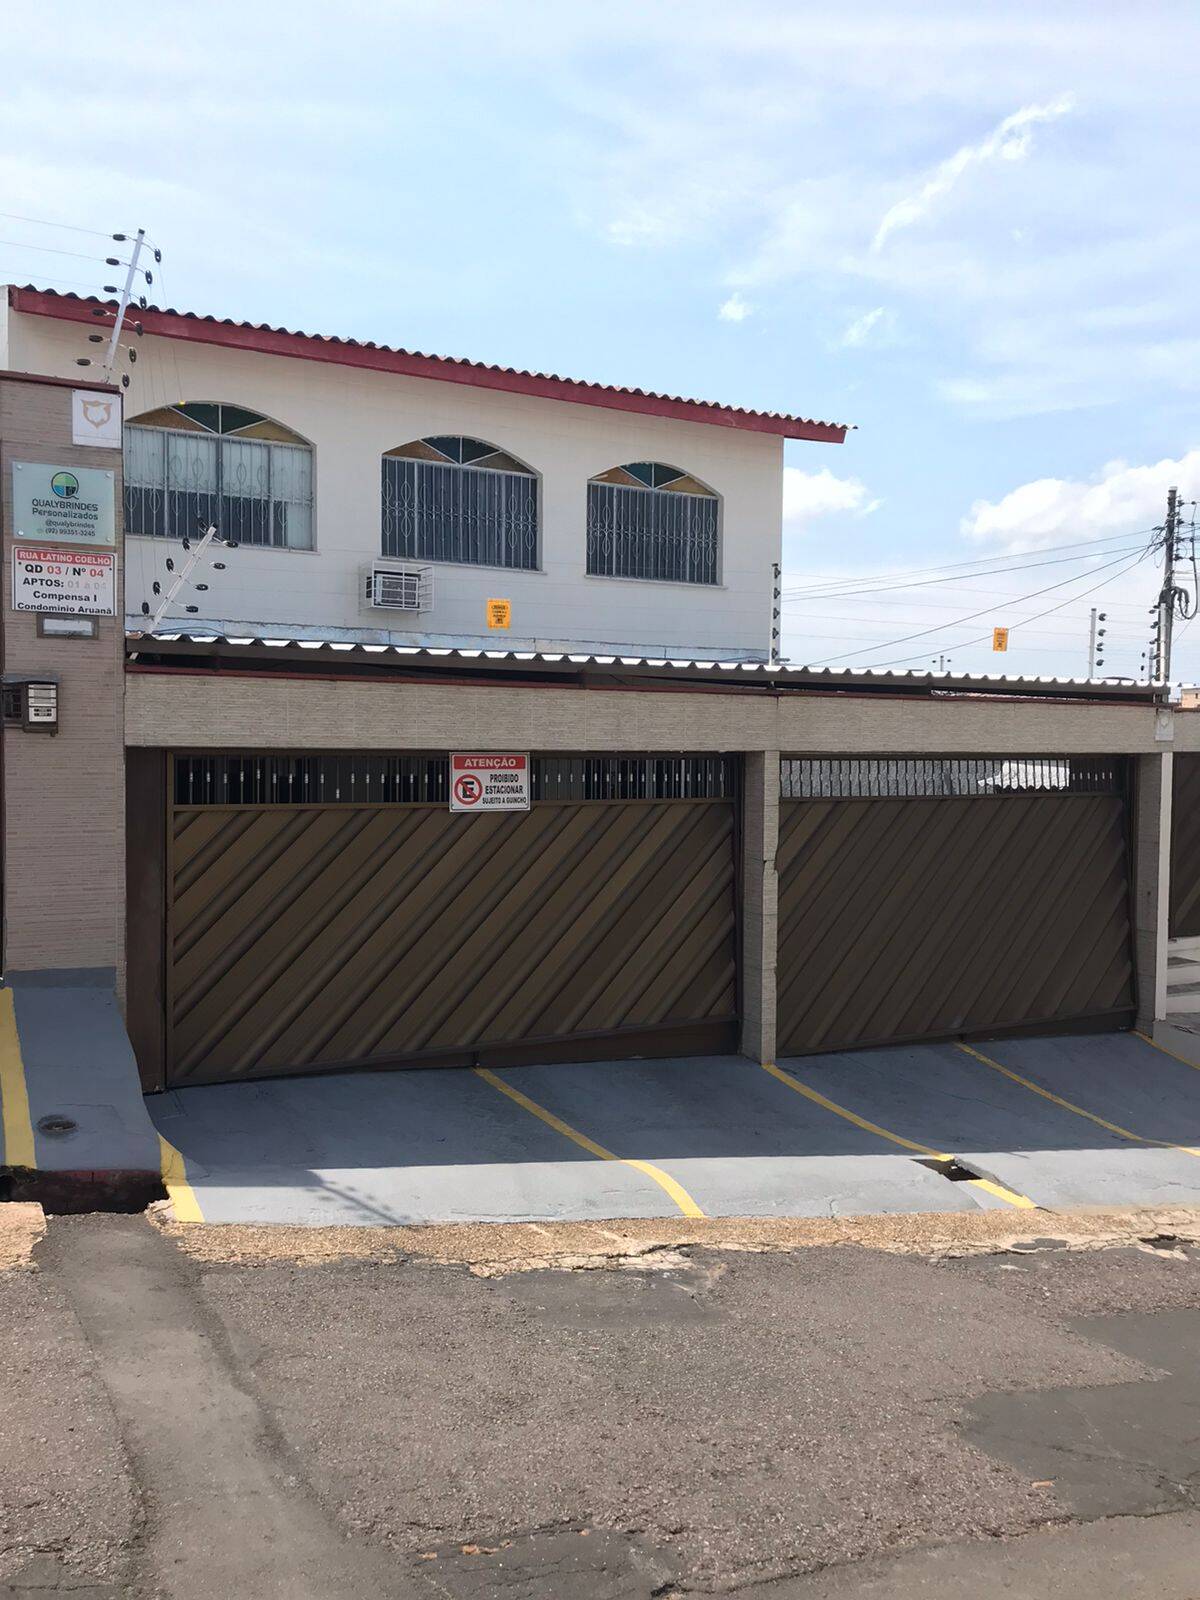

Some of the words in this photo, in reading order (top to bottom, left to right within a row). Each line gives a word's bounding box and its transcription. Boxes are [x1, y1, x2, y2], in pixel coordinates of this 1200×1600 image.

[32, 498, 98, 512] QUALYBRINDES
[32, 508, 98, 520] Personalizados
[45, 519, 95, 529] @qualybrindes
[20, 551, 38, 560] RUA
[40, 552, 72, 563] LATINO
[74, 555, 110, 565] COELHO
[25, 564, 43, 574] QD
[47, 565, 62, 575] 03
[89, 568, 104, 578] 04
[22, 577, 64, 588] APTOS:
[33, 591, 90, 602] Compensa
[464, 757, 517, 769] ATENÇÃO
[490, 774, 519, 783] PROIBIDO
[485, 785, 523, 794] ESTACIONAR
[506, 796, 527, 804] GUINCHO
